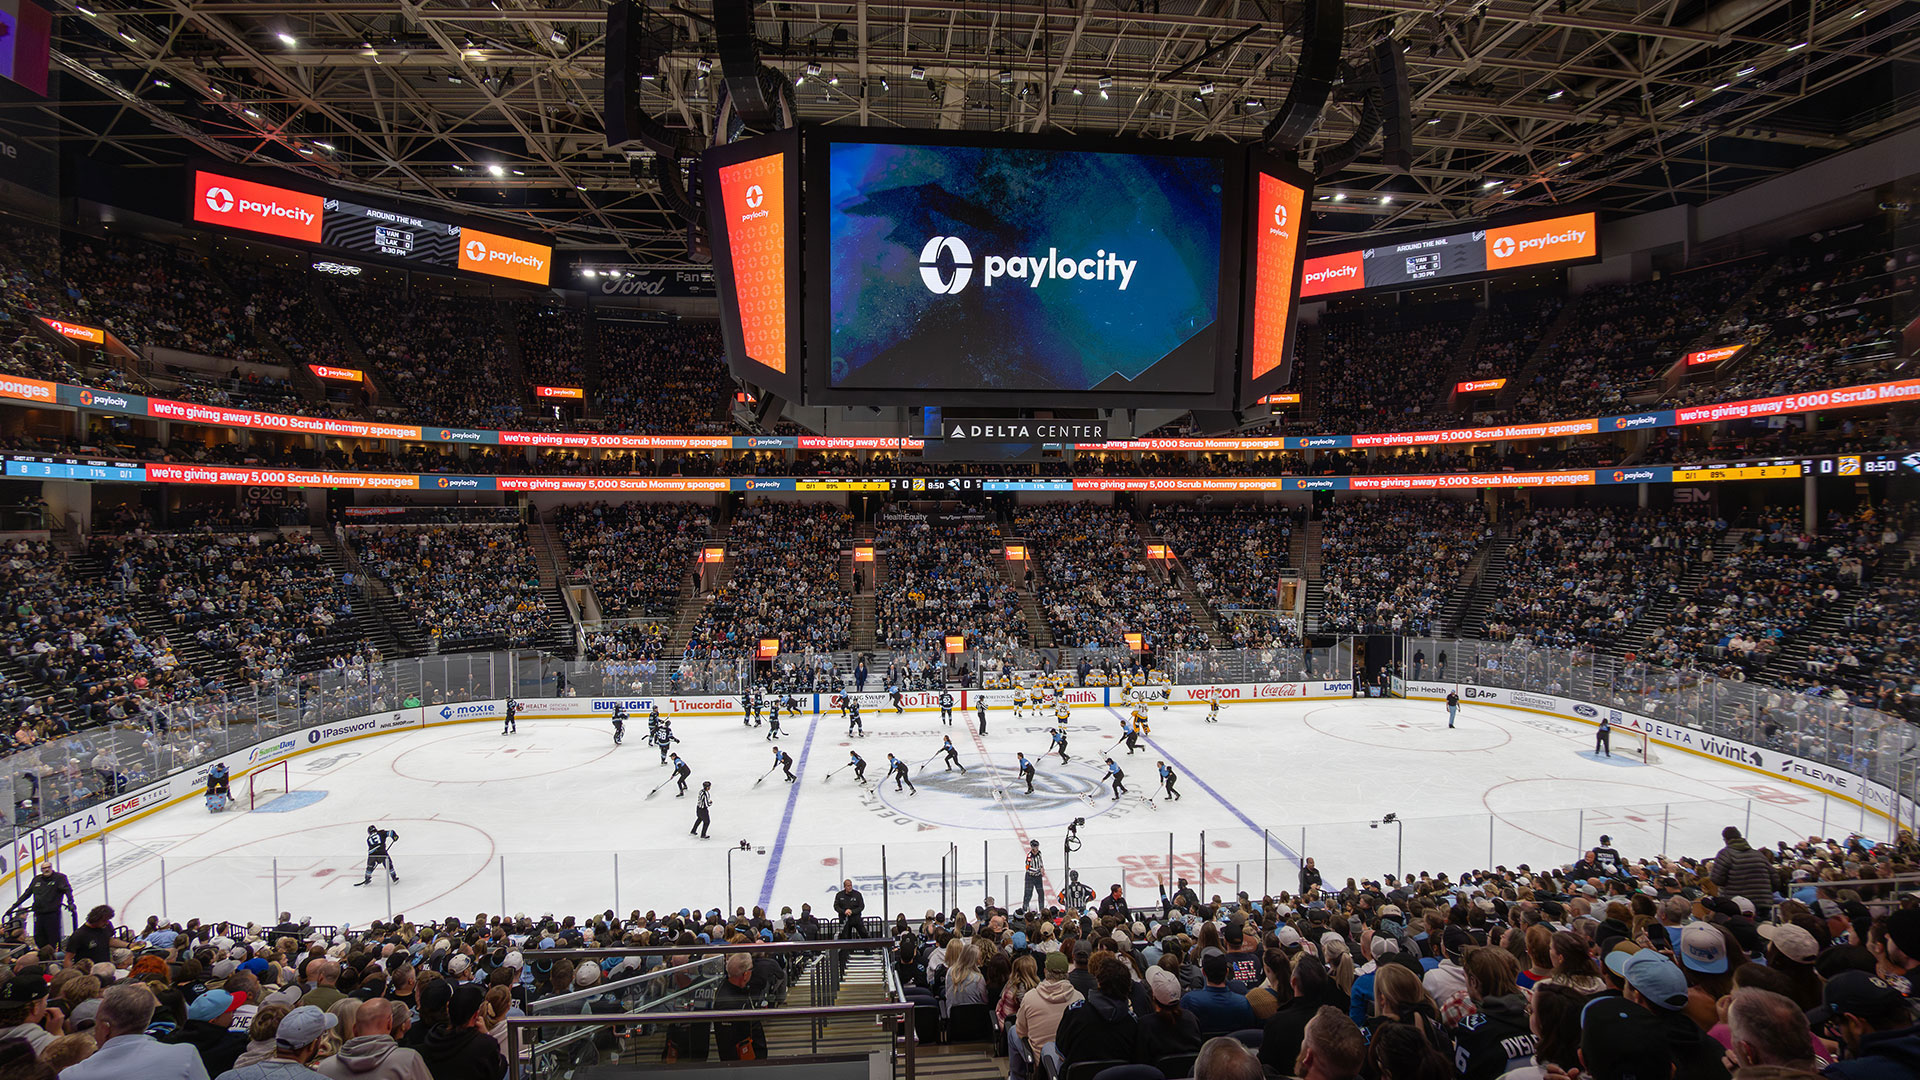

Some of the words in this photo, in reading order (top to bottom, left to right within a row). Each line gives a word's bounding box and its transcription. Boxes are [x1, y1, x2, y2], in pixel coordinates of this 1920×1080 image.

[239, 199, 315, 226] paylocity
[367, 209, 395, 221] AROUND
[396, 214, 409, 224] THE
[410, 218, 423, 227] NHL
[742, 209, 769, 223] paylocity
[386, 230, 399, 238] VAN
[385, 238, 398, 247] LAK
[1397, 241, 1420, 252] AROUND
[1421, 240, 1434, 249] THE
[1434, 238, 1448, 247] NHL
[1519, 230, 1586, 252] paylocity
[397, 248, 407, 257] PM
[489, 250, 544, 271] paylocity
[1415, 256, 1428, 264] VAN
[984, 247, 1138, 290] paylocity
[676, 272, 699, 282] Fan
[1305, 265, 1358, 285] paylocity
[602, 270, 667, 295] Ford
[63, 327, 94, 339] paylocity
[94, 396, 128, 408] paylocity
[1680, 407, 1710, 421] we're
[1711, 403, 1748, 421] giving
[1750, 401, 1784, 414] away
[1785, 397, 1829, 410] 5,000
[1831, 388, 1876, 404] Scrub
[154, 403, 185, 416] we're
[186, 406, 221, 423] giving
[222, 412, 252, 426] away
[254, 414, 288, 427] 5,000
[290, 418, 323, 430] Scrub
[325, 421, 369, 436] Mommy
[370, 426, 417, 438] sponges
[1627, 415, 1657, 427] paylocity
[451, 432, 481, 441] paylocity
[971, 426, 1029, 438] DELTA
[1036, 426, 1102, 438] CENTER
[1356, 436, 1382, 444] we're
[1383, 434, 1413, 445] giving
[1414, 434, 1440, 443] away
[1441, 431, 1473, 442] 5,000
[1474, 428, 1504, 439] Scrub
[1505, 427, 1547, 438] Mommy
[1548, 423, 1593, 435] sponges
[503, 433, 531, 443] we're
[532, 434, 563, 446] giving
[564, 436, 589, 446] away
[591, 436, 621, 446] 5,000
[622, 436, 650, 445] Scrub
[651, 437, 688, 448] Mommy
[689, 439, 728, 448] sponges
[802, 438, 826, 446] we're
[827, 437, 854, 448] giving
[855, 439, 879, 448] away
[880, 438, 907, 447] 5,000
[1129, 440, 1151, 450] away
[1151, 440, 1178, 448] 5,000
[1178, 439, 1204, 448] Scrub
[1205, 439, 1240, 449] Mommy
[1241, 440, 1280, 449] sponges
[1309, 437, 1336, 446] paylocity
[45, 466, 51, 475] 3
[1803, 465, 1810, 474] 3
[1821, 460, 1832, 473] 0
[1864, 460, 1896, 472] 8:50
[90, 468, 106, 477] 11%
[151, 467, 182, 479] we're
[183, 468, 218, 483] giving
[219, 472, 250, 484] away
[251, 471, 285, 484] 5,000
[287, 473, 321, 484] Scrub
[322, 474, 366, 487] Mommy
[367, 477, 414, 488] sponges
[1624, 471, 1654, 481] paylocity
[449, 479, 478, 488] paylocity
[501, 479, 528, 488] we're
[529, 479, 560, 490] giving
[561, 481, 587, 490] away
[588, 480, 618, 490] 5,000
[619, 480, 648, 489] Scrub
[649, 480, 686, 490] Mommy
[687, 481, 726, 491] sponges
[902, 480, 909, 489] 0
[963, 480, 971, 489] 0
[1076, 480, 1099, 488] we're
[1100, 480, 1125, 490] giving
[1125, 481, 1148, 490] away
[1149, 480, 1176, 489] 5,000
[1177, 480, 1202, 489] Scrub
[1203, 480, 1238, 490] Mommy
[1239, 481, 1277, 491] sponges
[1307, 480, 1333, 489] paylocity
[1354, 478, 1379, 487] we're
[1380, 478, 1411, 489] giving
[1412, 479, 1438, 488] away
[1439, 476, 1470, 487] 5,000
[1471, 475, 1501, 485] Scrub
[1502, 475, 1544, 486] Mommy
[1545, 474, 1590, 485] sponges
[247, 487, 283, 500] G2G
[883, 513, 928, 521] HealthEquity
[1324, 682, 1352, 693] Layton
[1421, 686, 1447, 694] Health
[1065, 690, 1097, 703] mith's
[457, 704, 495, 713] moxie
[593, 700, 614, 710] BUD
[619, 700, 652, 710] LIGHT
[679, 700, 733, 710] Trucordia
[1576, 705, 1595, 717] Ford
[322, 719, 376, 739] 1Password
[1645, 722, 1692, 744] DELTA
[1700, 737, 1748, 764] vivint
[1793, 763, 1848, 788] FILEVINE
[112, 797, 140, 816] SME
[1117, 852, 1208, 871] SEAT
[1124, 868, 1236, 888] GEEK
